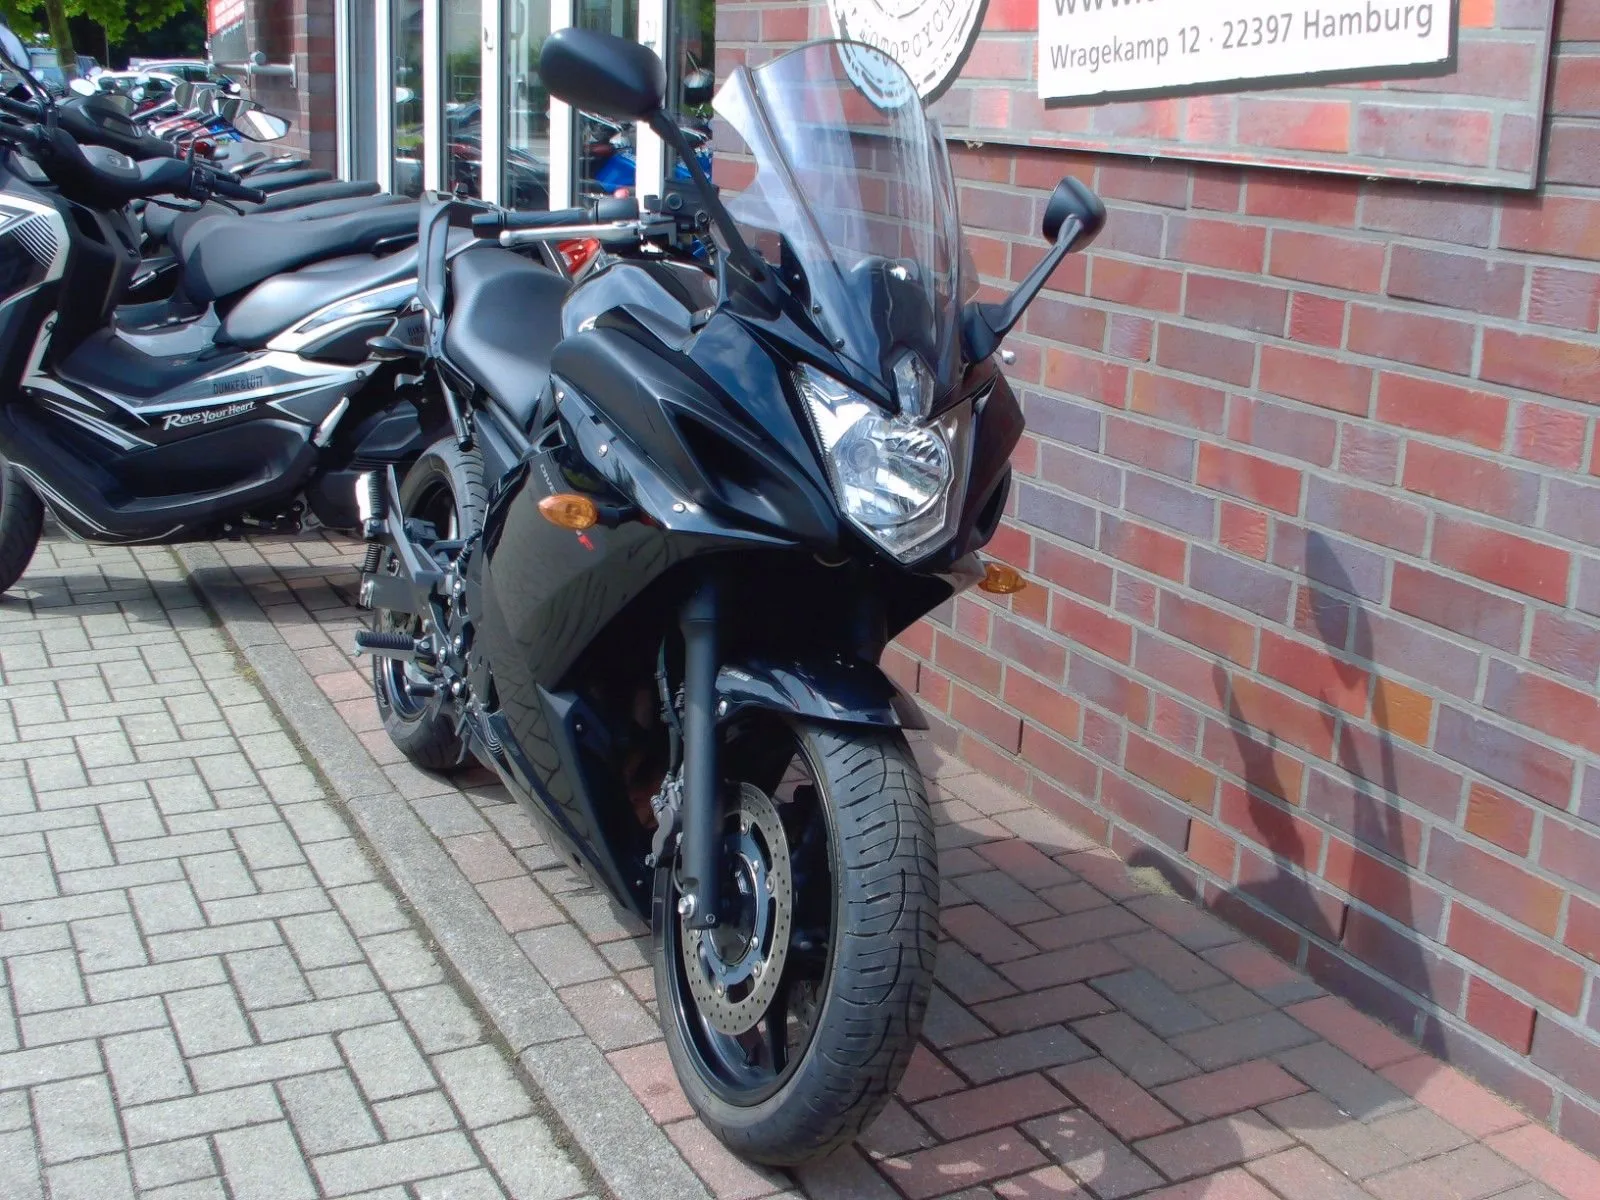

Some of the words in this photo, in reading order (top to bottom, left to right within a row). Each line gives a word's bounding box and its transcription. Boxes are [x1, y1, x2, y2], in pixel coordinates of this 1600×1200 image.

[1050, 35, 1169, 73] Wragekamp
[1178, 25, 1201, 55] 12
[1221, 12, 1293, 50] 22397
[1303, 1, 1433, 39] Hamburg
